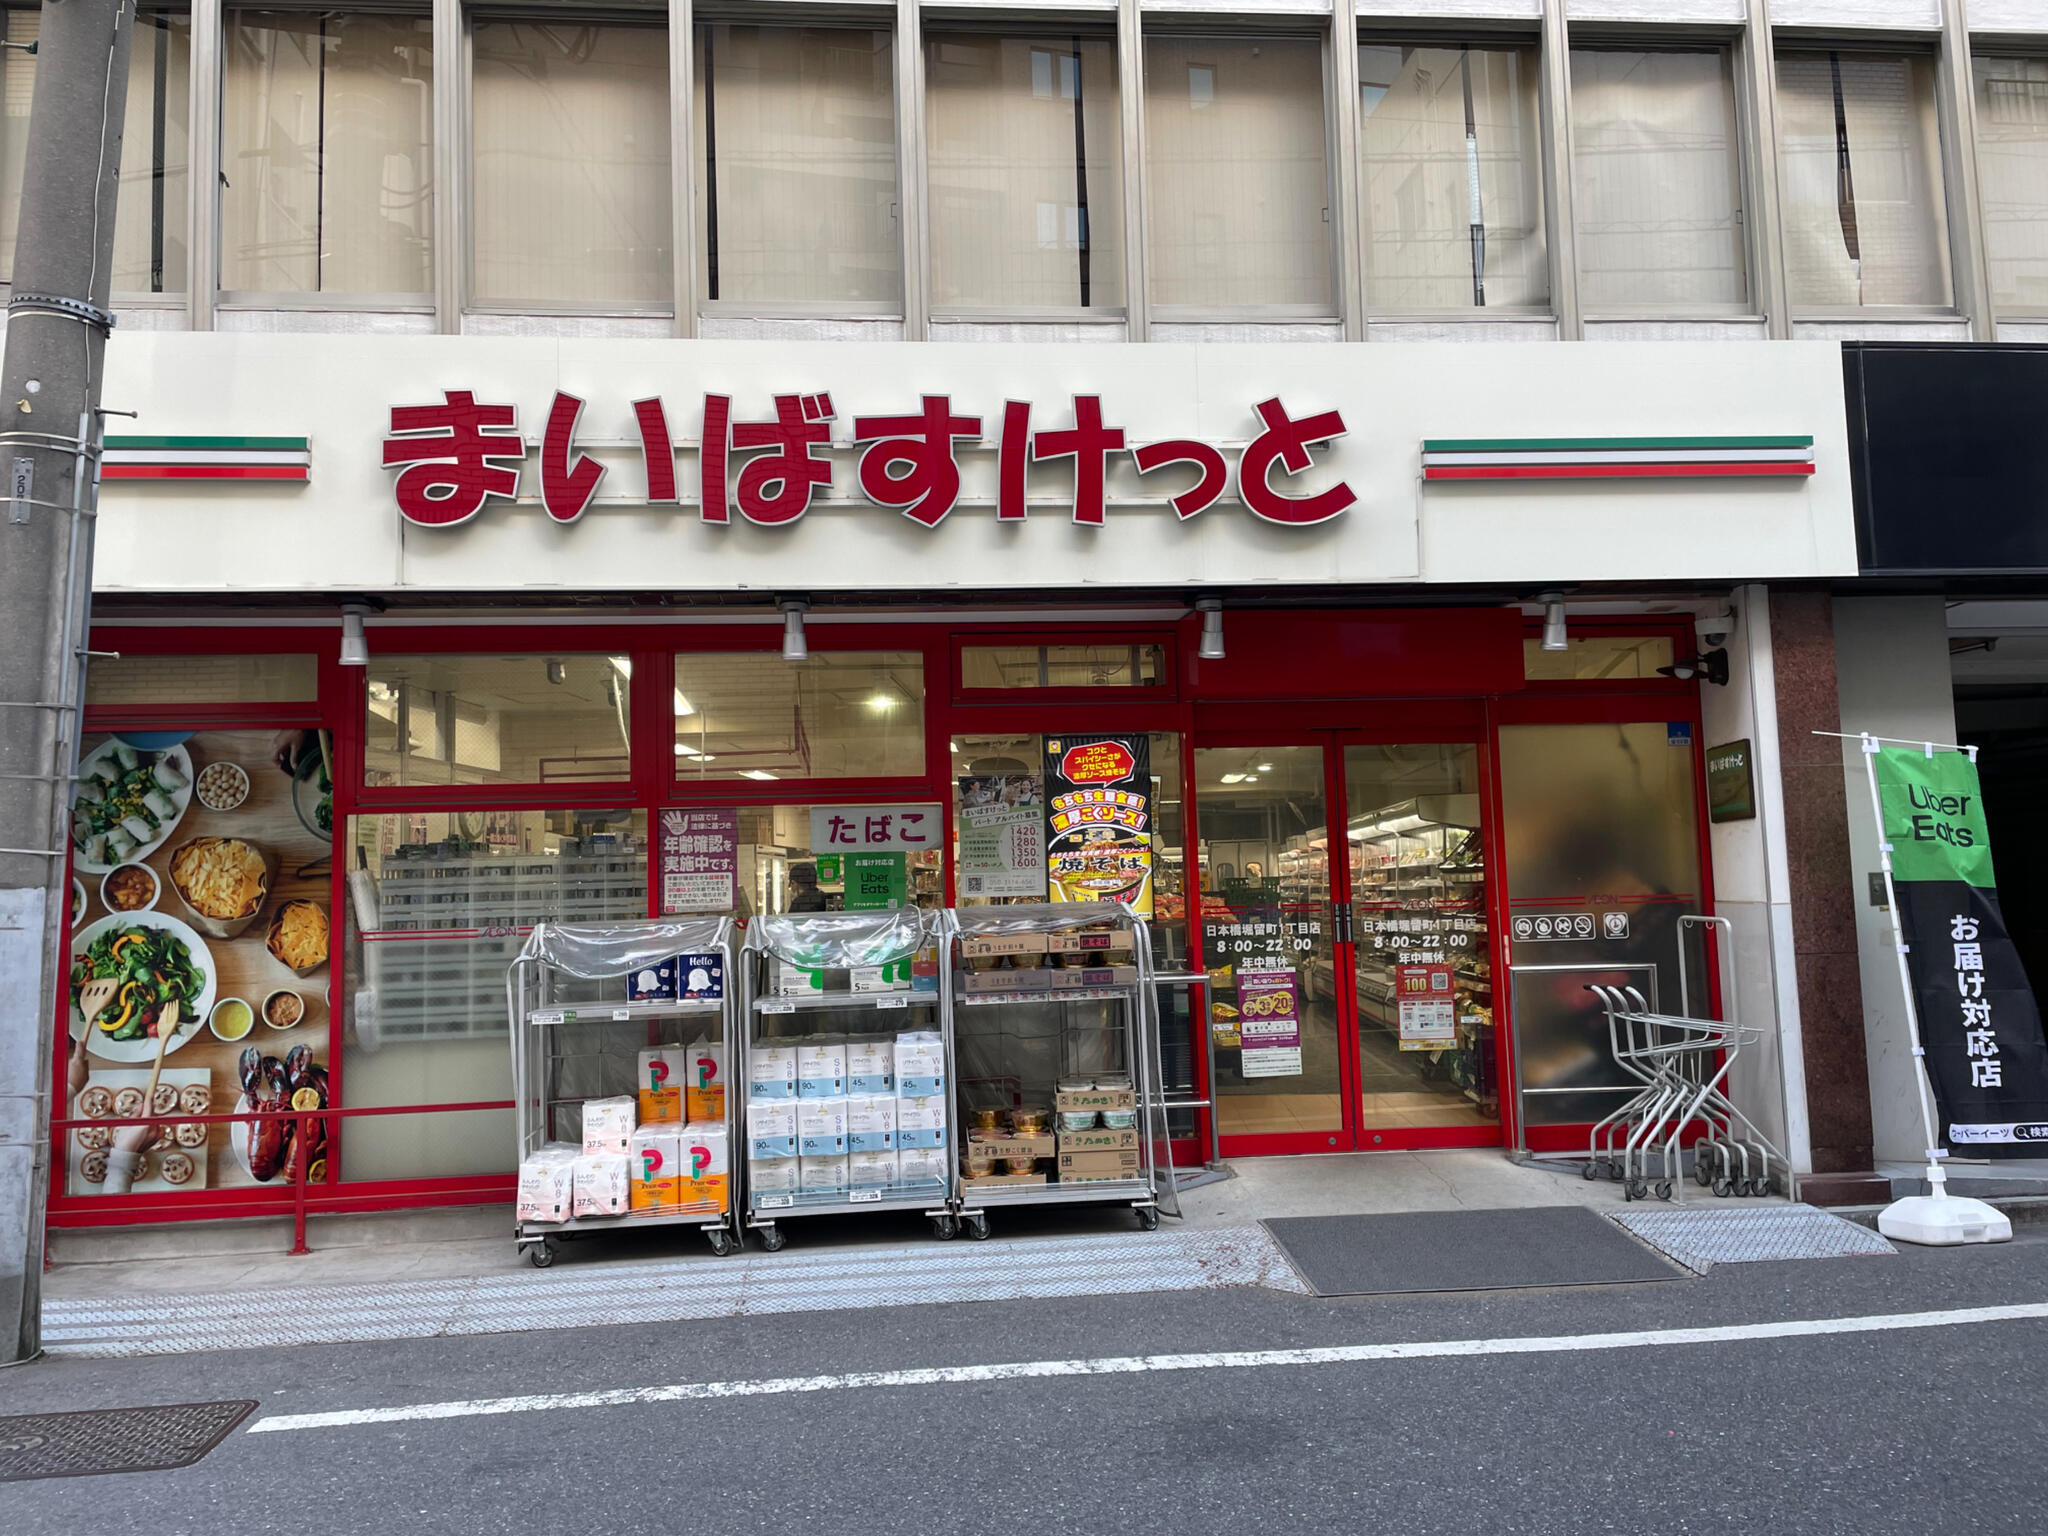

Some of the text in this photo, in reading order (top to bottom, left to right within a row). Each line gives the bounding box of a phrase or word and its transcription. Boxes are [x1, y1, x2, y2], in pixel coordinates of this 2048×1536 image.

[380, 388, 1358, 528] まいばすけっと
[1908, 783, 1971, 816] Uber
[828, 814, 926, 843] たばこ
[1912, 815, 1974, 847] Eats
[664, 835, 732, 854] 年齢確認を
[664, 855, 734, 872] 実施中です。
[1059, 856, 1143, 872] 焼そば
[860, 872, 889, 882] Uber
[861, 884, 889, 894] Eats
[689, 957, 713, 966] Hello
[1242, 956, 1288, 968] 年中無休
[1399, 952, 1445, 963] 年中無休
[1404, 978, 1426, 991] 100
[1951, 915, 2002, 1088] お届け対応店
